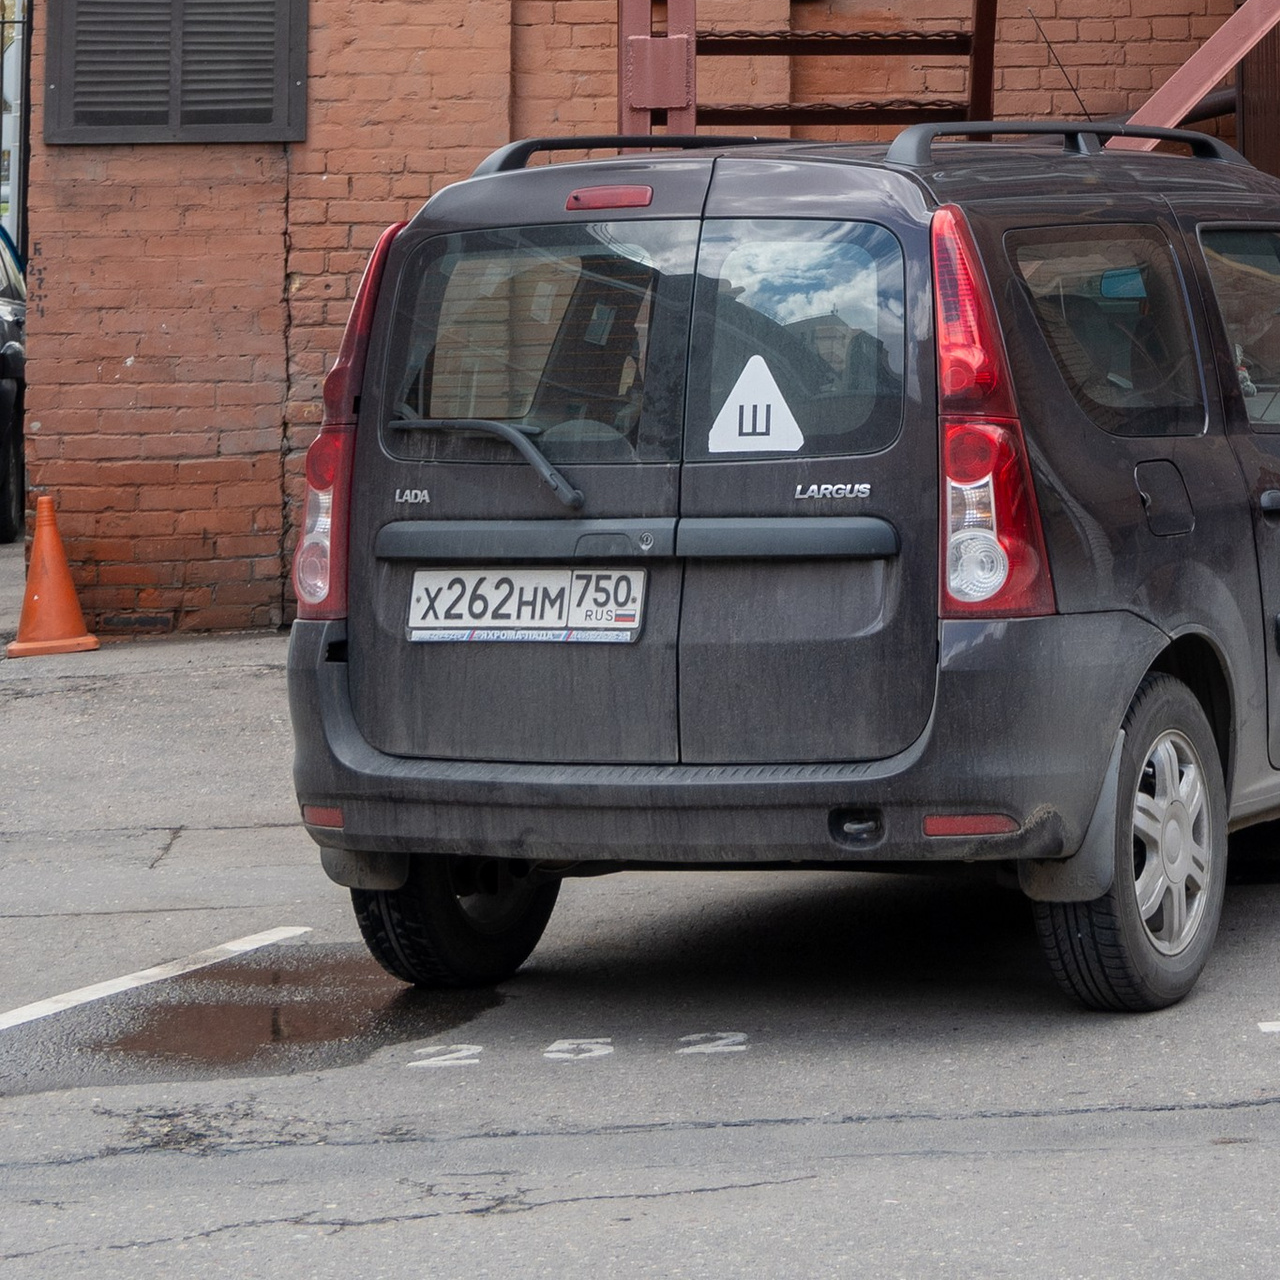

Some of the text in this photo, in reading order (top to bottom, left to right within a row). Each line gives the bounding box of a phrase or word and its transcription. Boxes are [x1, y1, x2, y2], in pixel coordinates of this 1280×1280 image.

[738, 404, 771, 437] Ш
[395, 489, 430, 503] LADA
[794, 483, 871, 499] LARGUS
[575, 574, 632, 608] 750
[584, 609, 613, 622] RUS
